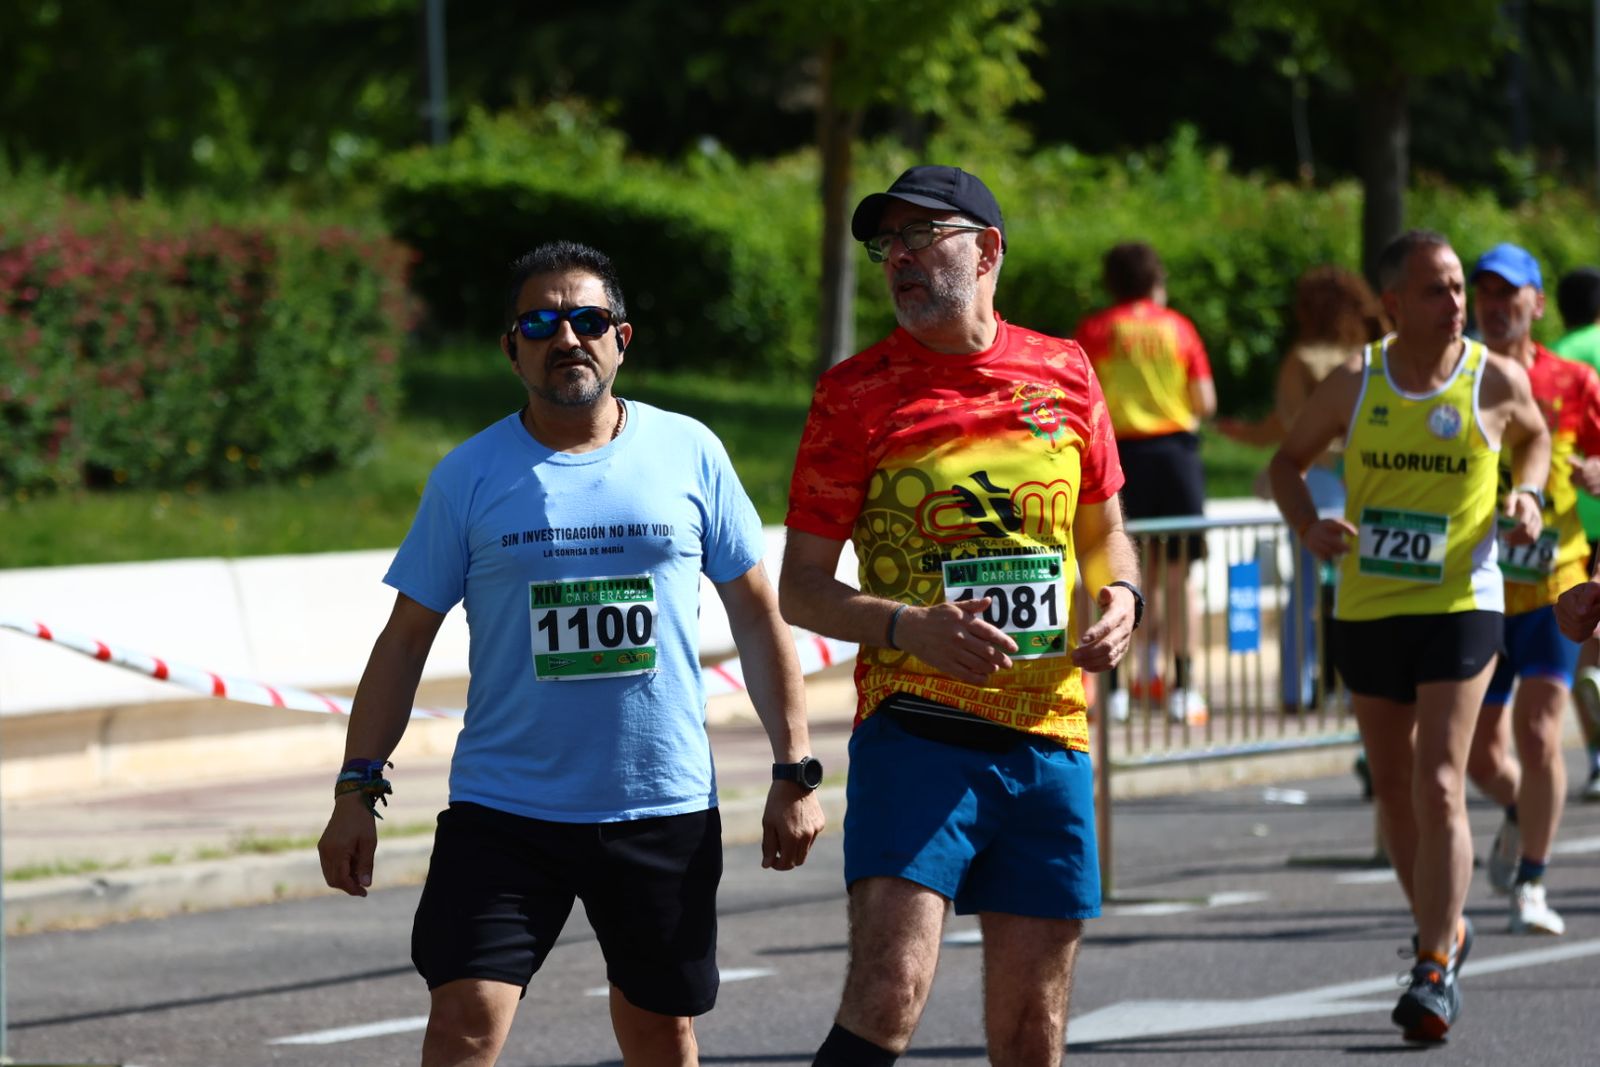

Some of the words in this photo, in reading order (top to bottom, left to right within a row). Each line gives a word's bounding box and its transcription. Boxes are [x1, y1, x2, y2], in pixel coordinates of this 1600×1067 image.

[502, 533, 518, 547] SIN
[523, 523, 605, 543] INVESTIGACIÓN
[609, 525, 623, 538] NO
[628, 524, 648, 537] HAY
[652, 524, 674, 537] VIDA
[543, 549, 553, 558] LA
[555, 548, 587, 557] SONRISA
[590, 547, 599, 556] DE
[1371, 529, 1431, 562] 720
[981, 569, 1036, 582] CARRERA
[534, 586, 562, 605] XIV
[566, 584, 586, 594] SAN
[566, 591, 622, 603] CARRERA
[538, 604, 652, 652] 1100
